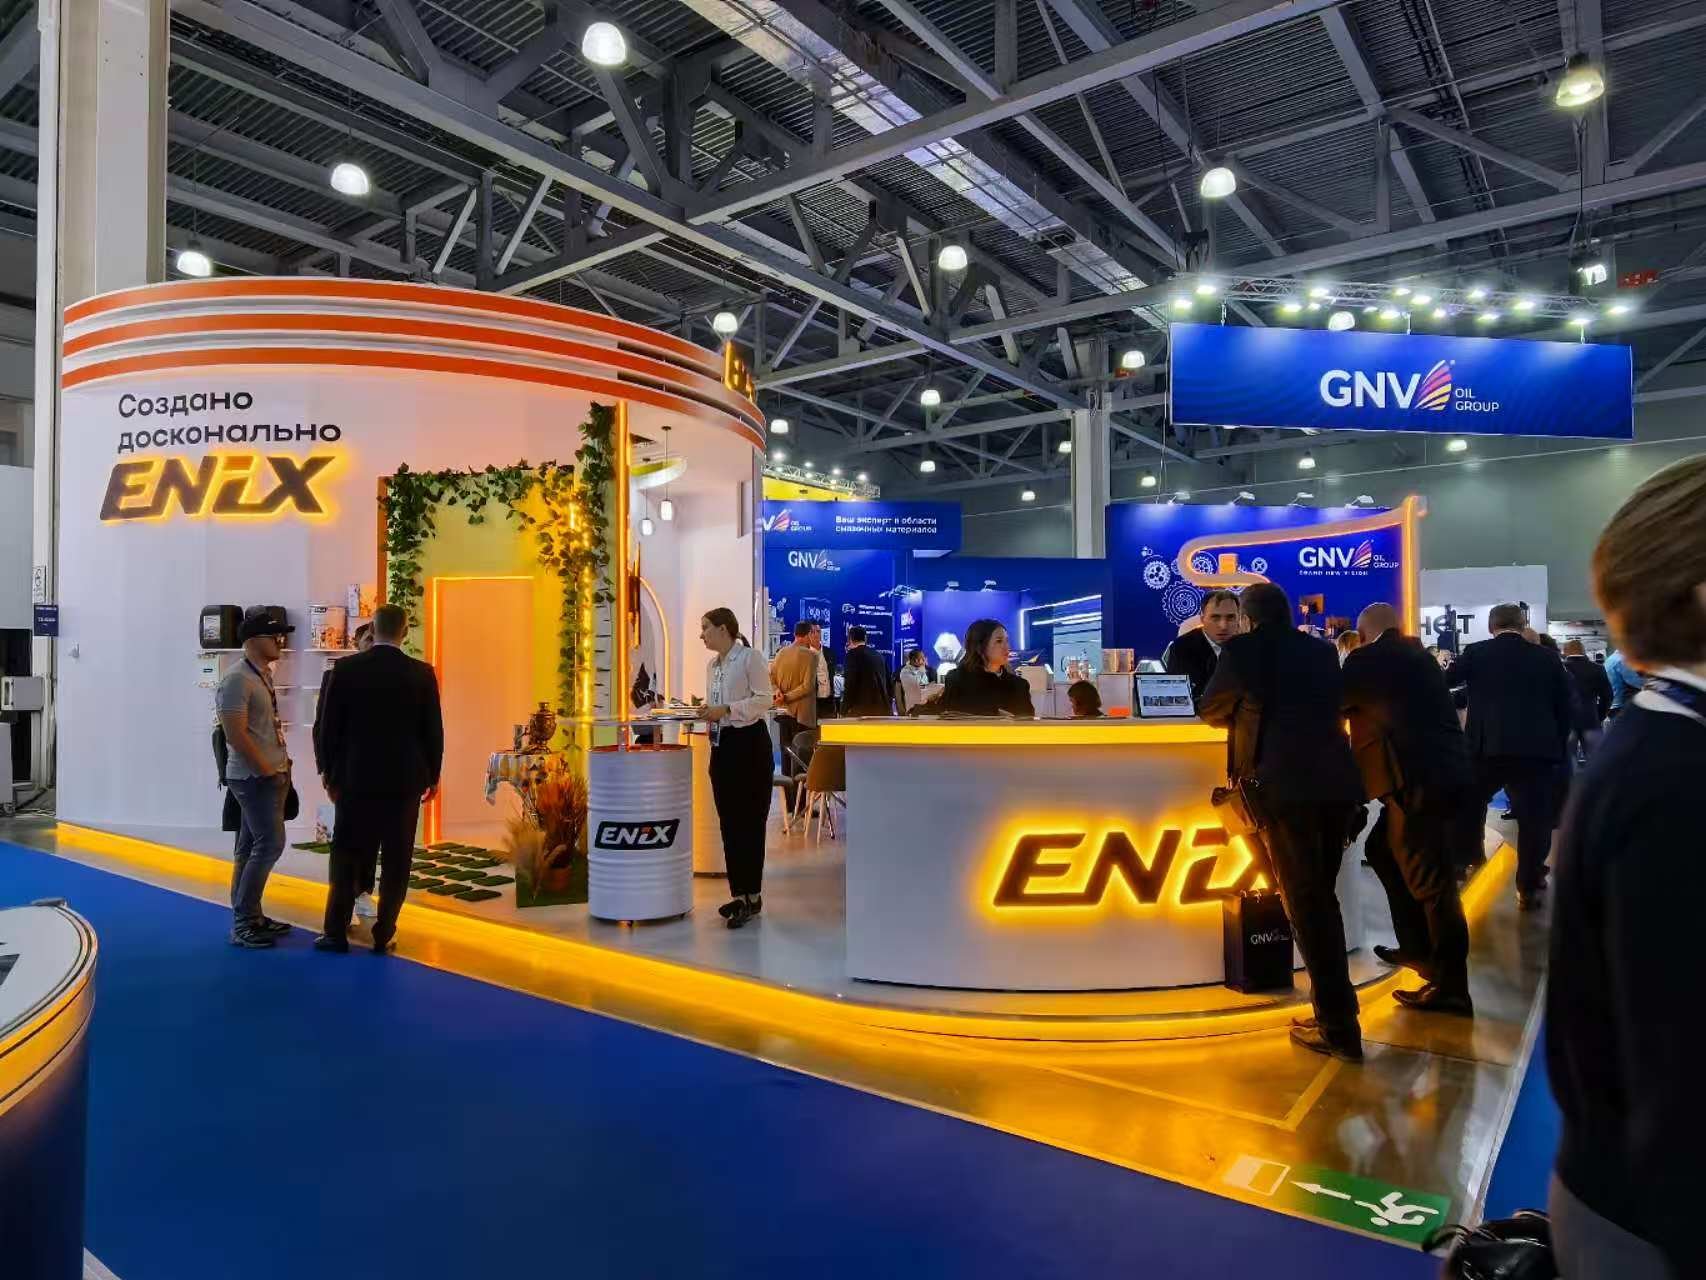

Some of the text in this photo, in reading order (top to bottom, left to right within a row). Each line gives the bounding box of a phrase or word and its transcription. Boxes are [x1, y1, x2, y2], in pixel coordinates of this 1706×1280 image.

[1320, 370, 1421, 408] GNV
[1455, 388, 1475, 398] OIL
[118, 391, 253, 418] Создано
[1455, 401, 1500, 411] GROUP
[118, 424, 342, 454] досконально
[835, 516, 855, 524] Ваш
[901, 516, 937, 525] области
[788, 550, 818, 569] GNV
[1299, 546, 1355, 568] GNV
[1250, 932, 1273, 945] GNV
